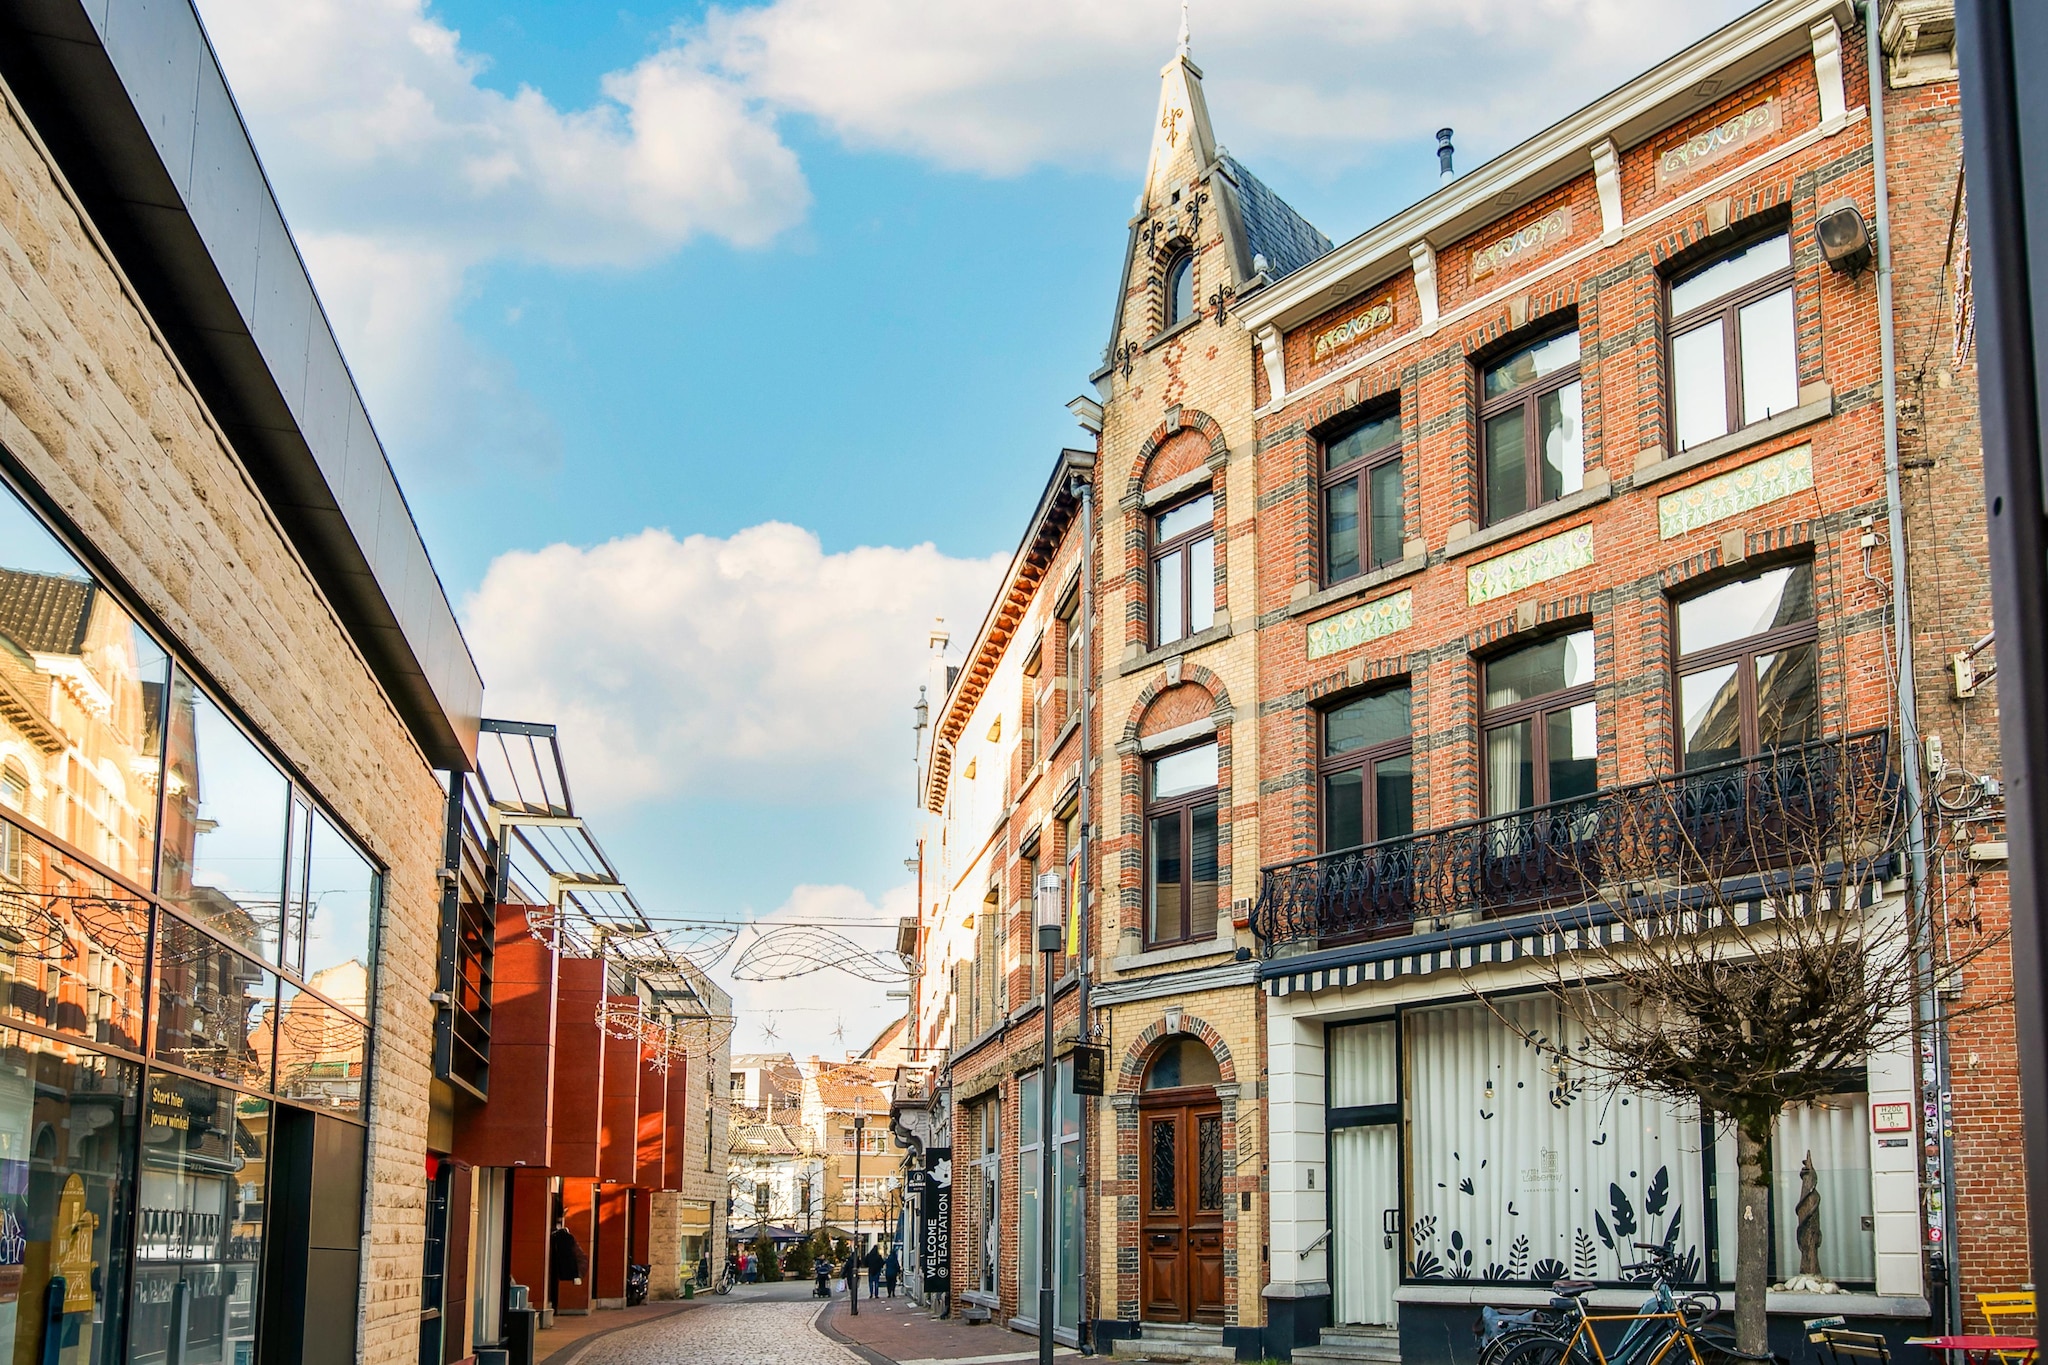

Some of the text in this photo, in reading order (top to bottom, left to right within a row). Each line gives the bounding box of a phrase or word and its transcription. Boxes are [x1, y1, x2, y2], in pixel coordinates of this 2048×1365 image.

[153, 1087, 184, 1108] Start hier
[151, 1109, 190, 1130] jouw winkel
[1881, 1105, 1902, 1113] H200
[937, 1193, 949, 1279] @ TEASTATION
[927, 1218, 937, 1279] WELCOME
